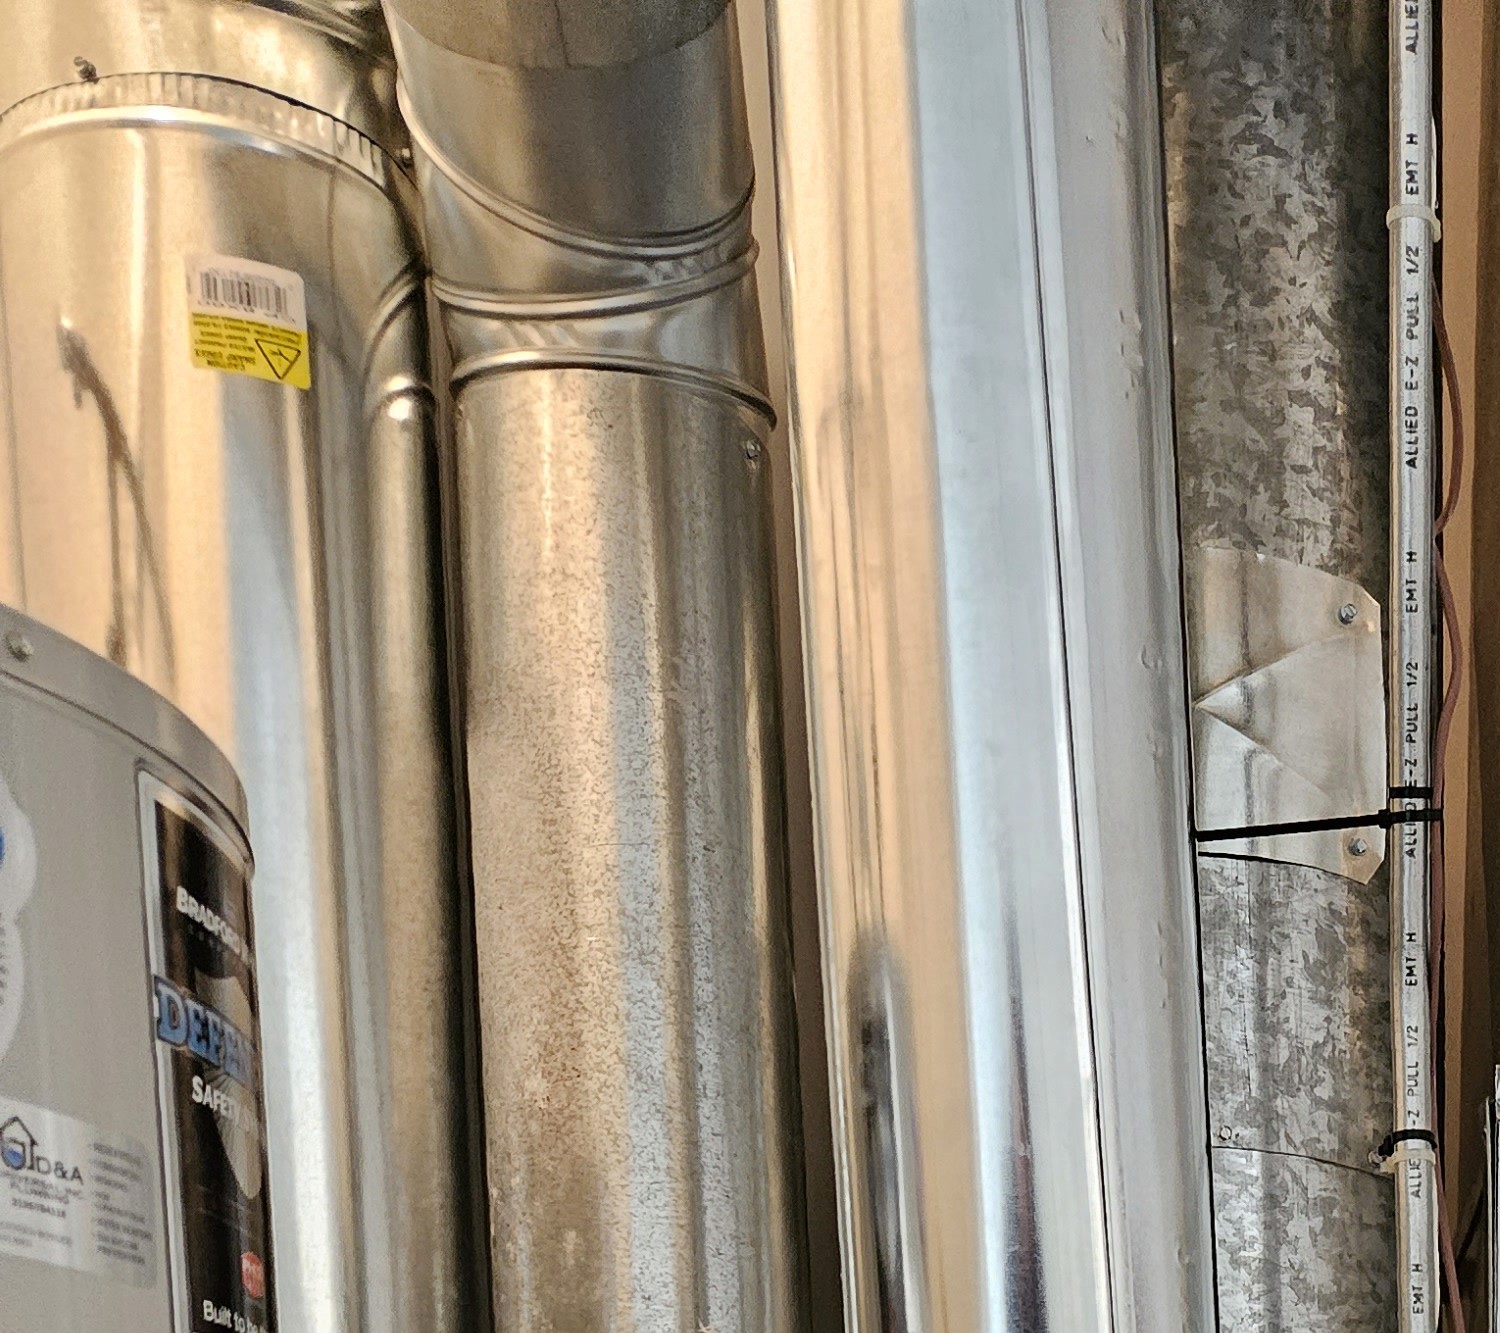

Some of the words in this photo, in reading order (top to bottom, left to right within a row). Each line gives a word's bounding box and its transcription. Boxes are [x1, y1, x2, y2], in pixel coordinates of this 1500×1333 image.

[1404, 0, 1419, 54] ALLIE
[1406, 133, 1418, 145] H
[1405, 160, 1419, 195] EMT
[1406, 245, 1419, 274] 1/2
[1406, 294, 1419, 341] PULL
[1405, 356, 1419, 391] E-Z
[1404, 405, 1419, 470] ALLIED
[1406, 551, 1418, 563] H
[1405, 579, 1419, 613] EMT
[1406, 662, 1419, 687] 1/2
[1405, 703, 1419, 744] PULL
[1404, 802, 1418, 859] ALLID
[1406, 931, 1417, 943] H
[1405, 955, 1418, 987] EMT
[1407, 1025, 1419, 1048] 1/2
[1407, 1061, 1419, 1097] PULL
[1408, 1158, 1422, 1199] ALLIE
[1412, 1285, 1425, 1315] EMT
